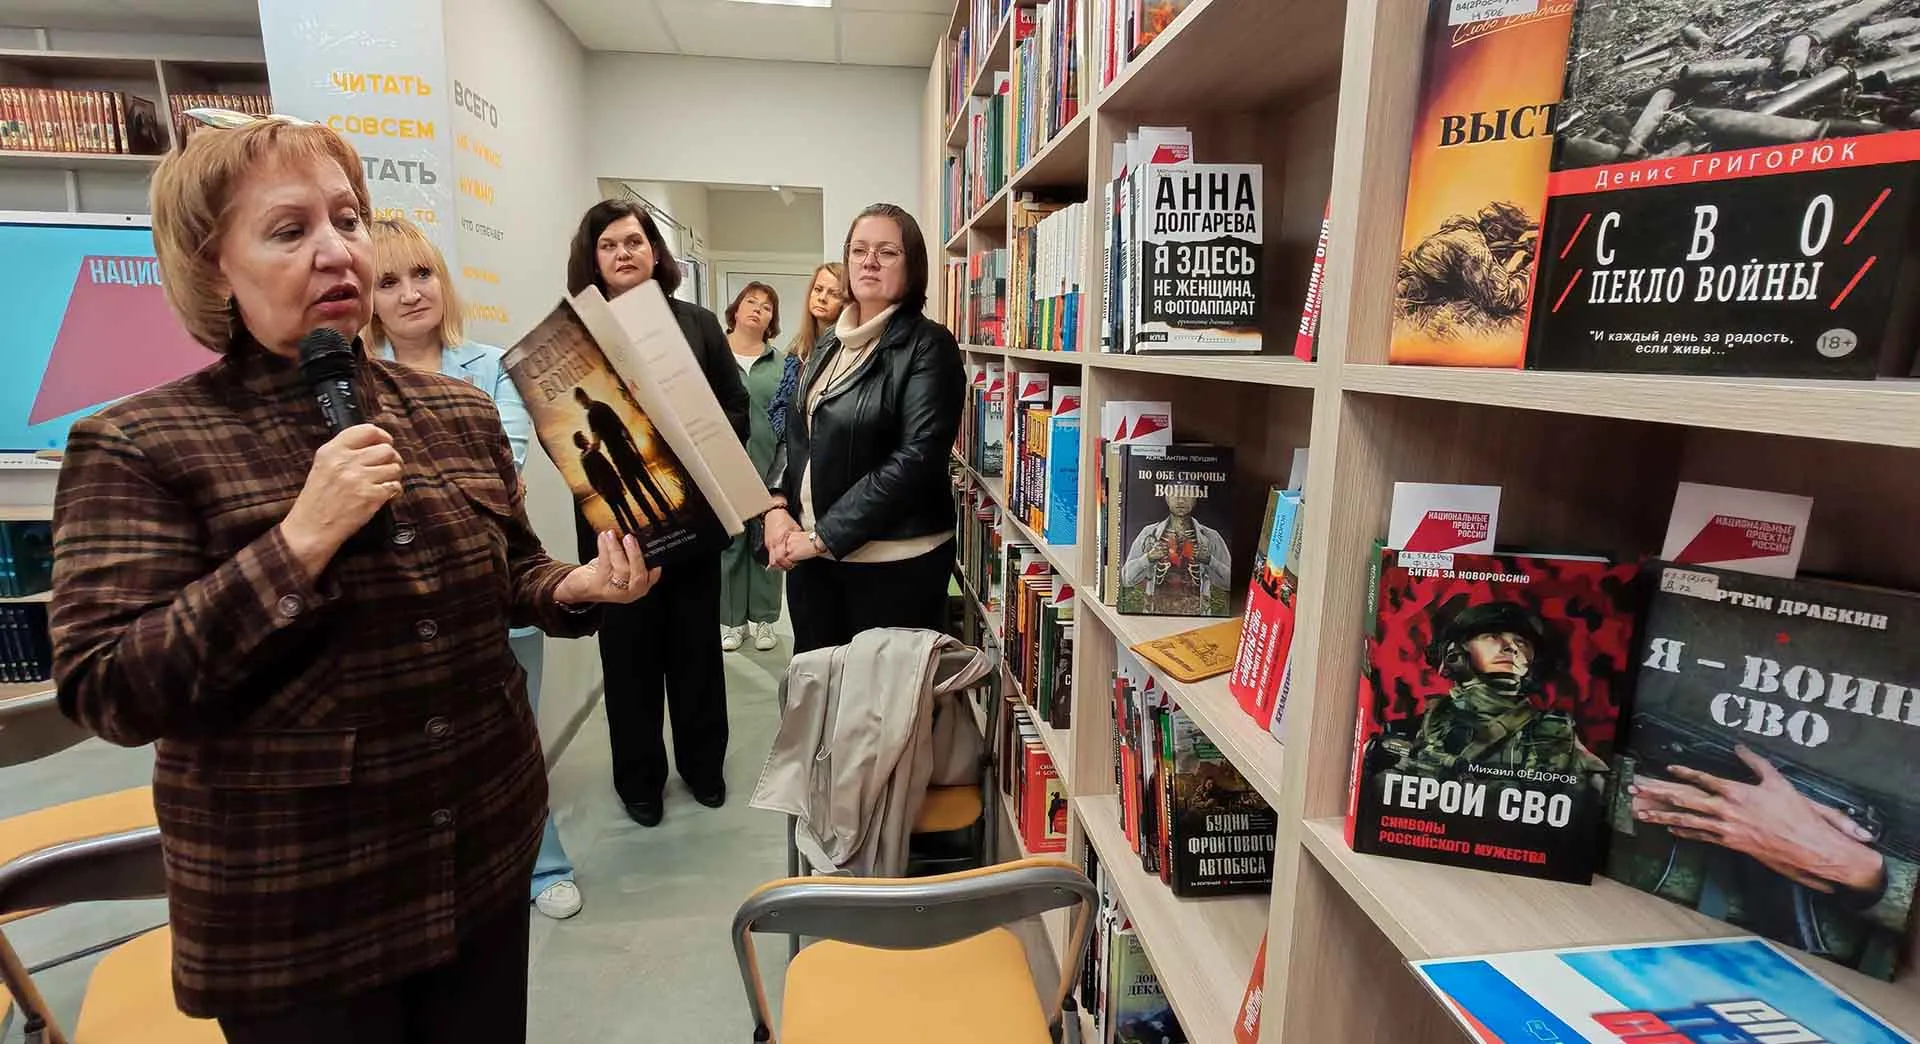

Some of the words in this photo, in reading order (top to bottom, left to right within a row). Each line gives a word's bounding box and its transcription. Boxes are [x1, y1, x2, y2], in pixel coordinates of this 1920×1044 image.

[333, 72, 431, 96] ЧИТАТЬ
[455, 80, 498, 128] ВСЕГО
[327, 114, 435, 140] СОВСЕМ
[1438, 103, 1560, 147] ВЫСТ
[360, 157, 437, 185] ТАТЬ
[1594, 164, 1675, 190] Денис
[1691, 142, 1858, 177] ГРИГОРЮК
[1156, 173, 1256, 211] АННА
[1154, 212, 1256, 234] ДОЛГАРЕВА
[1596, 211, 1621, 266] С
[1686, 204, 1720, 261] В
[1799, 194, 1835, 257] О
[1154, 246, 1168, 274] Я
[1177, 246, 1255, 278] ЗДЕСЬ
[89, 259, 162, 287] НАЦИО
[1588, 266, 1685, 304] ПЕКЛО
[1693, 258, 1824, 302] ВОЙНЫ
[1154, 280, 1171, 297] НЕ
[1176, 279, 1255, 299] ЖЕНЩИНА,
[1304, 262, 1323, 314] ЛИНИИ
[1154, 301, 1162, 315] Я
[1165, 300, 1255, 316] ФОТОАППАРАТ
[1299, 316, 1311, 337] НА
[1608, 329, 1660, 346] каждый
[1663, 331, 1699, 345] день
[1703, 332, 1720, 343] за
[1724, 331, 1795, 346] радость,
[1818, 334, 1855, 349] 18+
[1635, 344, 1668, 354] если
[1138, 470, 1152, 480] ПО
[1156, 470, 1175, 481] ОБЕ
[1178, 471, 1226, 481] СТОРОНЫ
[1155, 481, 1209, 498] ВОЙНЫ
[1428, 512, 1488, 522] НАЦИОНАЛЬНЫЕ
[1452, 521, 1487, 530] ПРОЕКТЫ
[1716, 517, 1793, 532] НАЦИОНАЛЬНЫЕ
[1457, 530, 1487, 538] РОССИИ
[1746, 529, 1792, 543] ПРОЕКТЫ
[1752, 540, 1790, 553] РОССИИ
[1408, 567, 1440, 578] БИТВА
[1443, 569, 1455, 579] ЗА
[1458, 570, 1531, 584] НОВОРОССИЮ
[1718, 589, 1773, 613] РТЕМ
[1777, 598, 1889, 630] ДРАБКИН
[1251, 607, 1262, 634] СВО
[1643, 637, 1686, 673] Я
[1739, 655, 1920, 726] ВОИН
[1710, 692, 1830, 747] СВО
[1468, 763, 1514, 778] Михаил
[1382, 773, 1487, 818] ГЕРОИ
[1498, 787, 1572, 829] СВО
[1206, 814, 1249, 833] БУДНИ
[1380, 816, 1446, 834] СИМВОЛЫ
[1188, 835, 1274, 854] ФРОНТОВОГО
[1378, 831, 1470, 856] РОССИЙСКОГО
[1474, 843, 1547, 864] МУЖЕСТВА
[1199, 857, 1266, 877] АВТОБУСА
